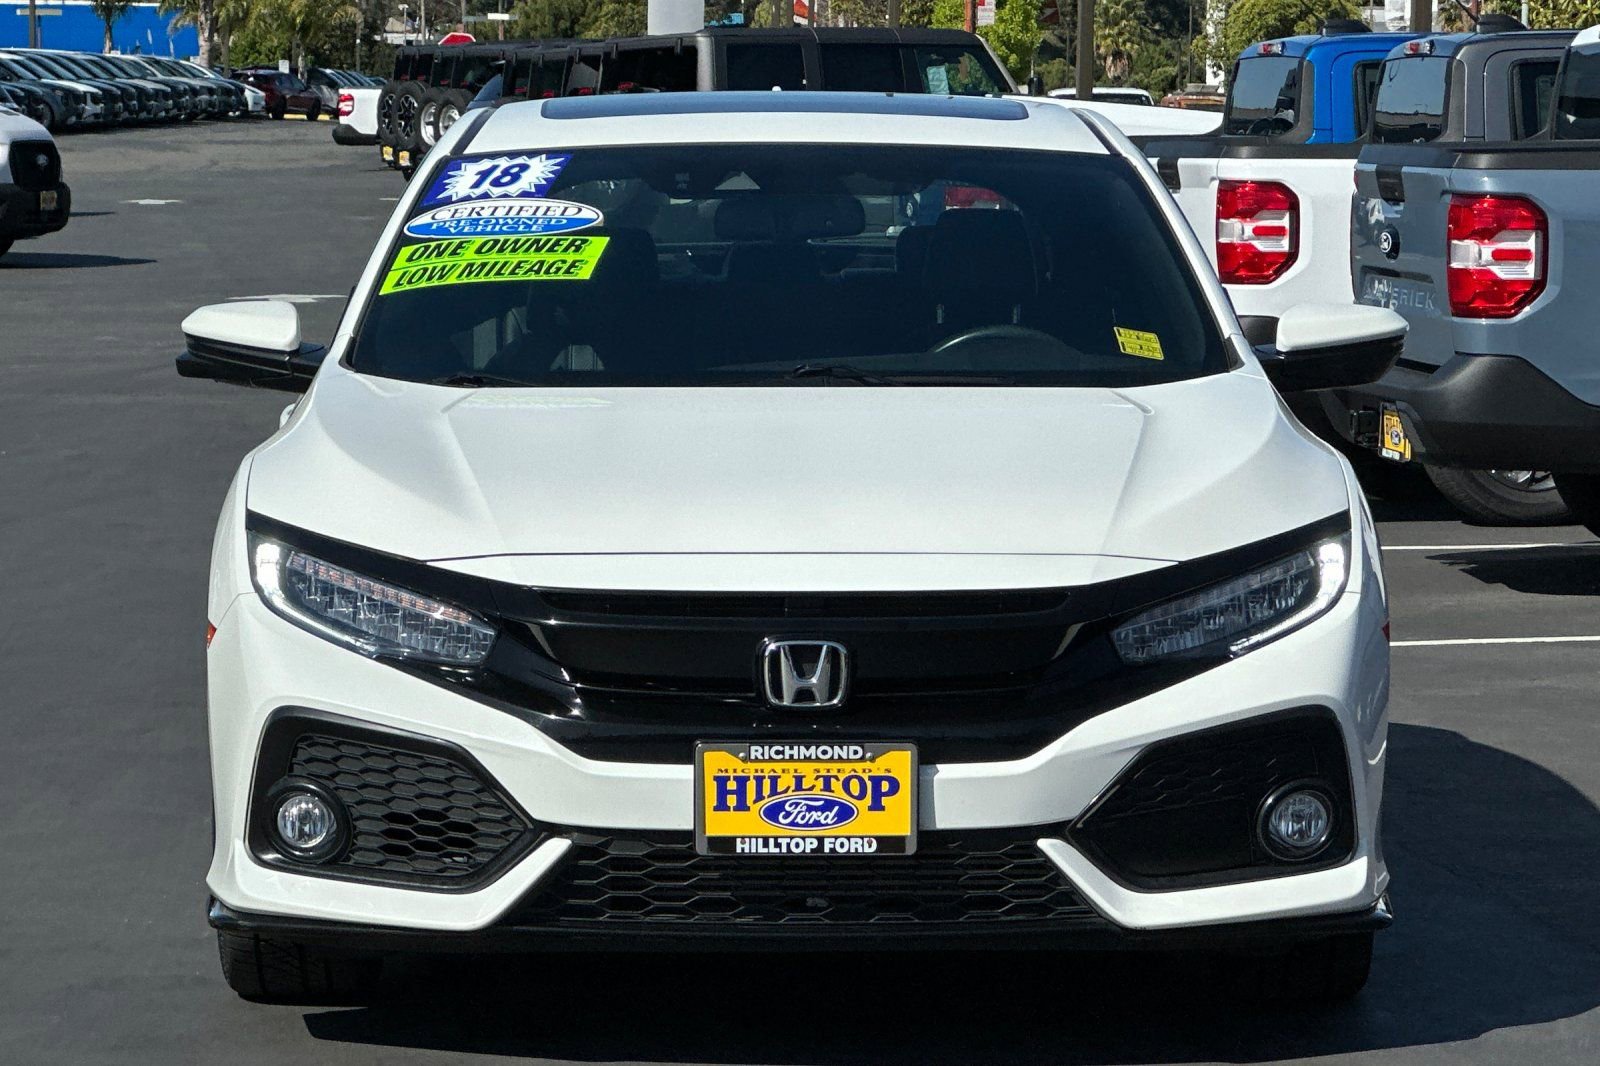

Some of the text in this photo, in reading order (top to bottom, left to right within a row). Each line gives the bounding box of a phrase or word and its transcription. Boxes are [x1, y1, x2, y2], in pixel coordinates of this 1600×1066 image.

[469, 163, 531, 189] 18
[431, 204, 583, 221] CERTIFIED
[430, 217, 568, 230] PRE-OWNED
[447, 224, 546, 234] VEHICLE
[405, 237, 592, 264] ONE OWNER
[391, 258, 590, 289] LOW MILEAGE
[750, 745, 863, 760] RICHMOND
[713, 775, 900, 811] HILLTOP
[778, 799, 838, 825] Ford
[736, 837, 877, 853] HILLTOP FORD
